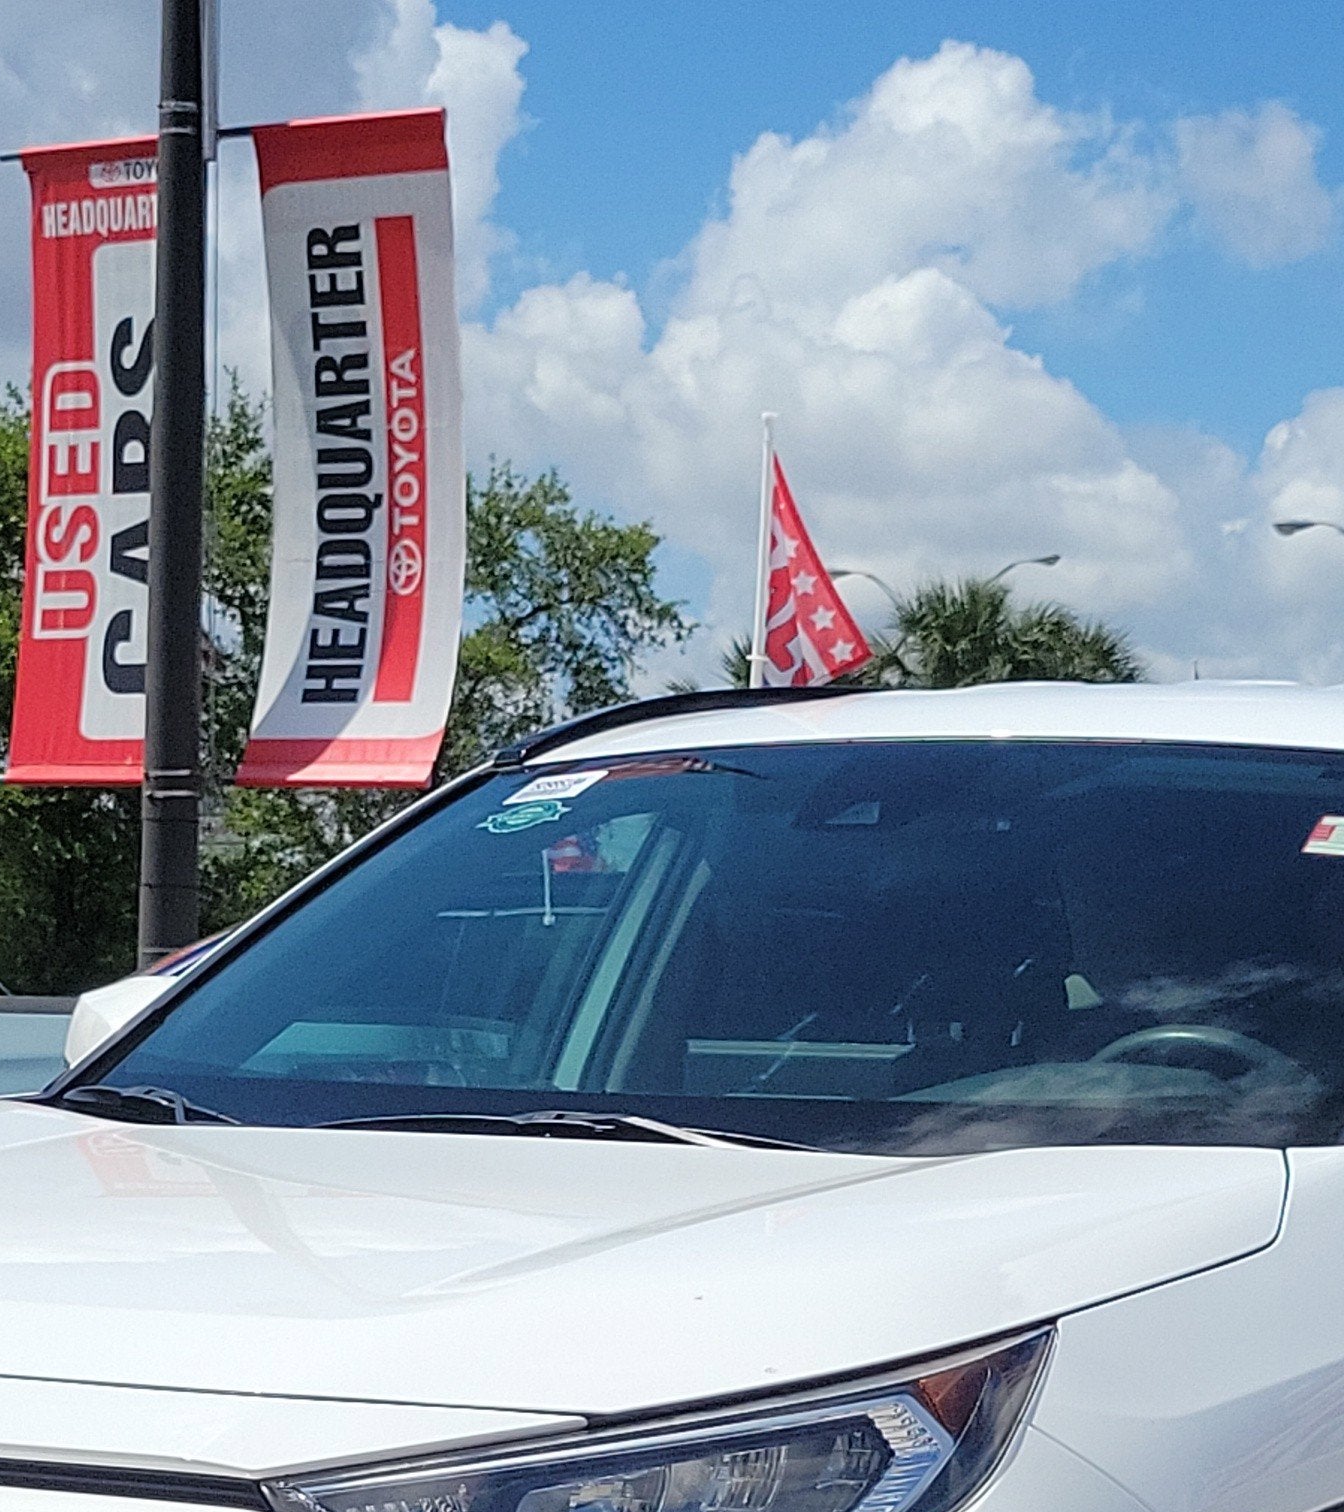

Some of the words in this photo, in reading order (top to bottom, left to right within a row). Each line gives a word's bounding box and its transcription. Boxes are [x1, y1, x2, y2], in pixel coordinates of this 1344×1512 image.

[123, 160, 158, 181] TOY
[37, 366, 101, 635] USED
[301, 223, 384, 704] HEADQUARTER
[389, 347, 422, 534] TOYOTA
